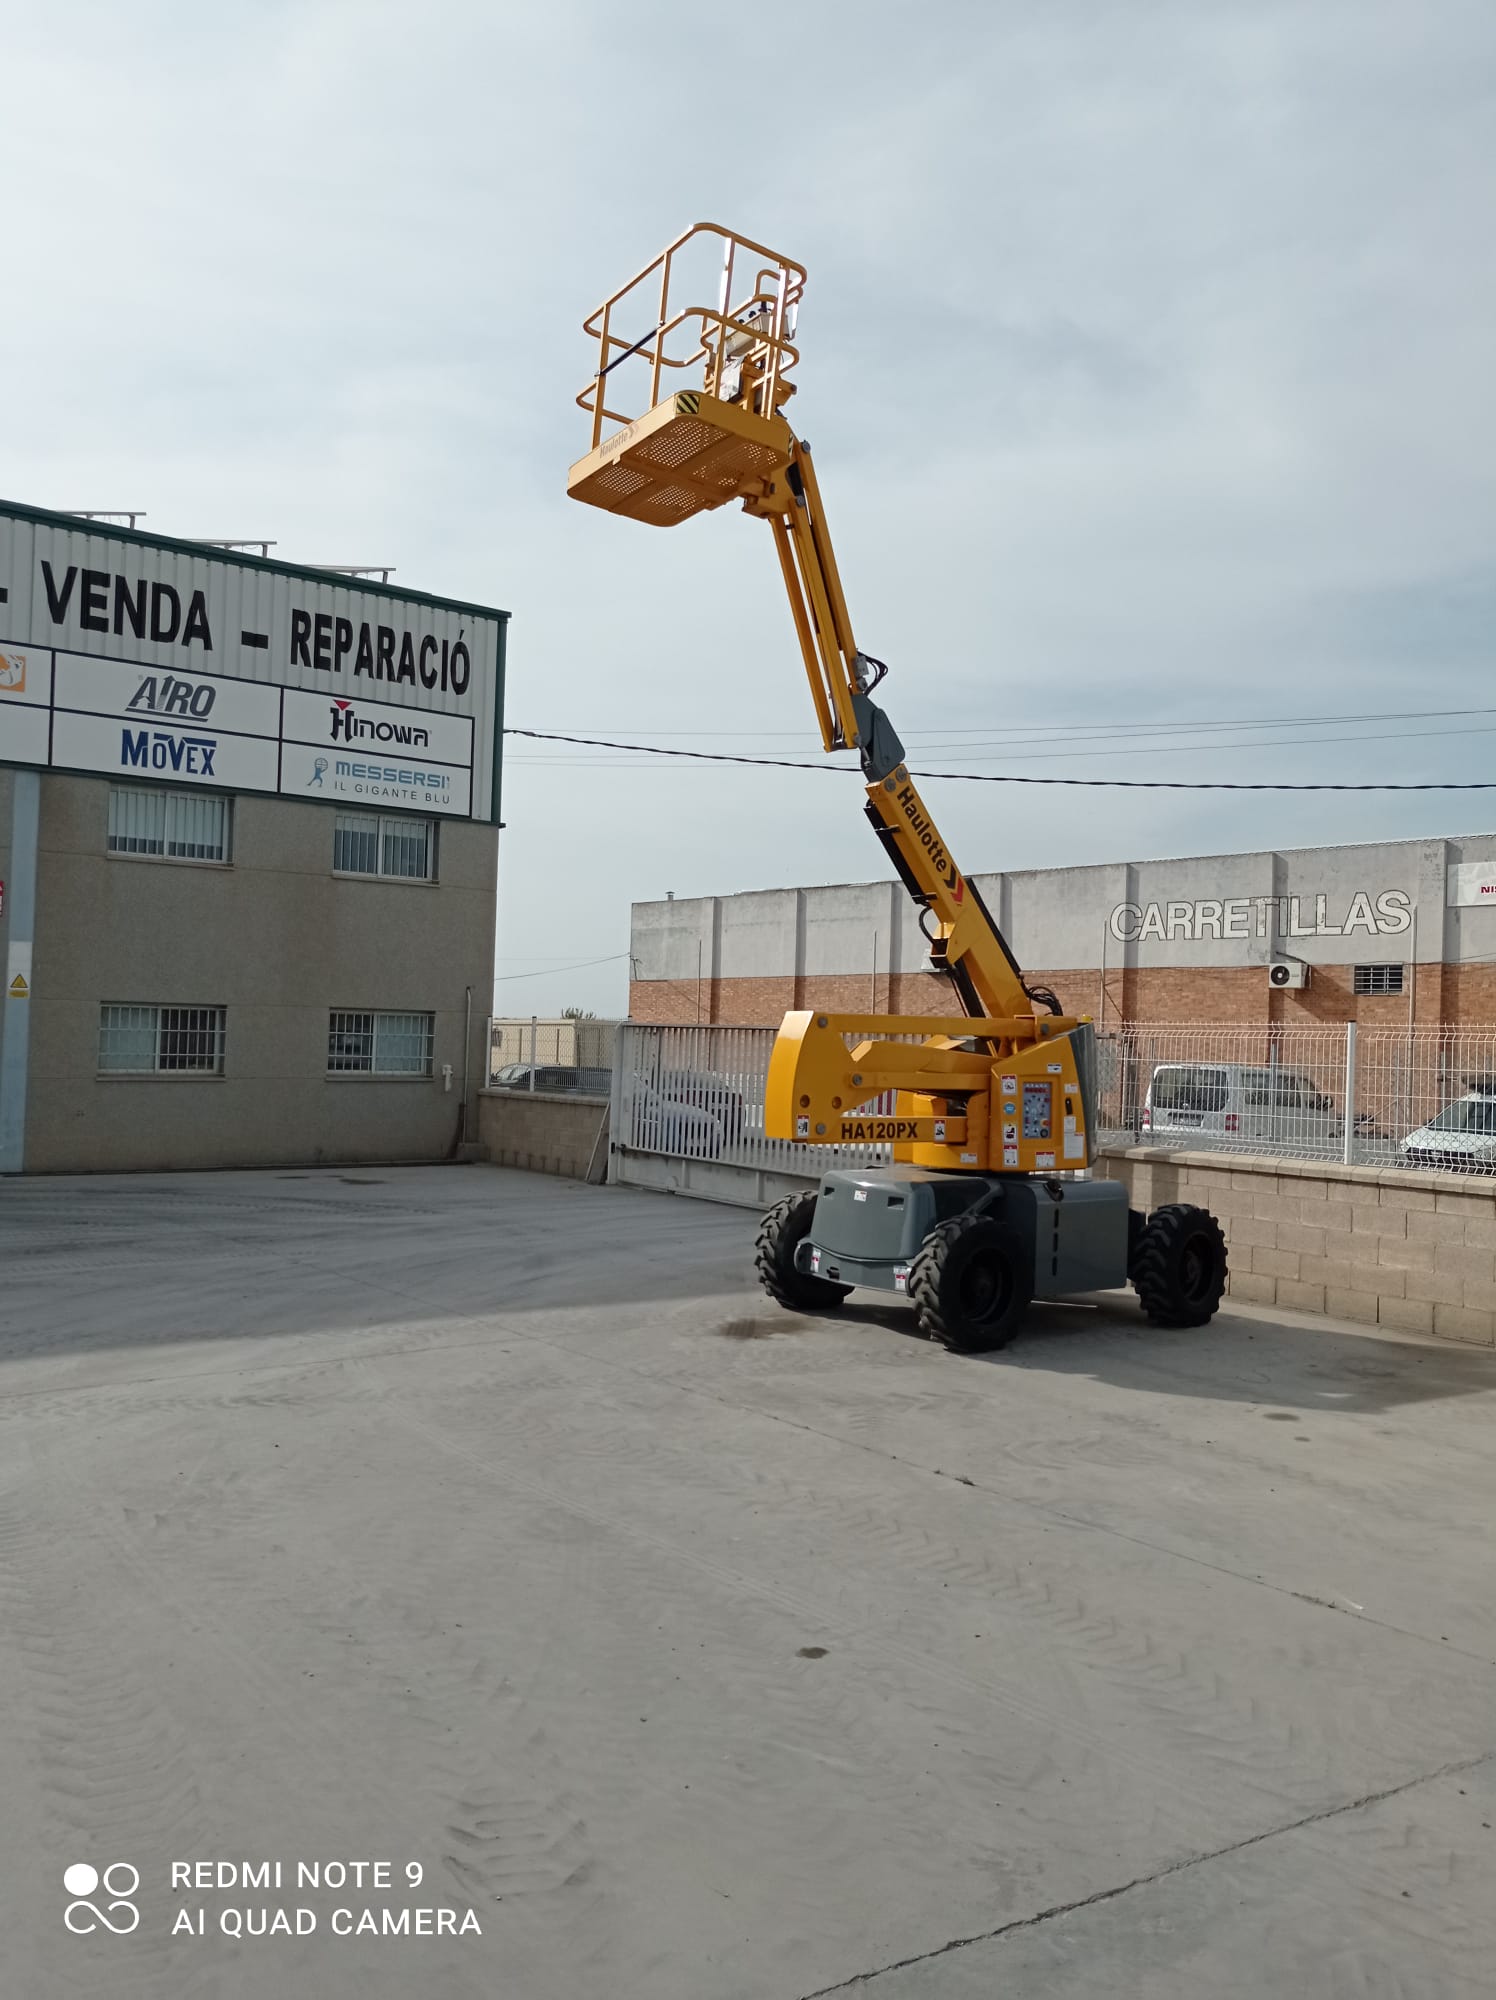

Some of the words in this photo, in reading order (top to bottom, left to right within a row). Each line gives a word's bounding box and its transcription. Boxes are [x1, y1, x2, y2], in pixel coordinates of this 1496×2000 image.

[41, 560, 213, 651] VENDA
[290, 608, 471, 696] REPARACIÓ
[127, 675, 217, 718] AIRO
[121, 728, 217, 776] MOVEX
[334, 781, 347, 791] IL
[354, 783, 418, 800] GIGANTE
[425, 792, 450, 804] BLU
[897, 785, 947, 873] Haulotte
[1480, 886, 1496, 894] NI
[1109, 889, 1412, 942] CARRETILLAS
[841, 1122, 918, 1139] HA120PX
